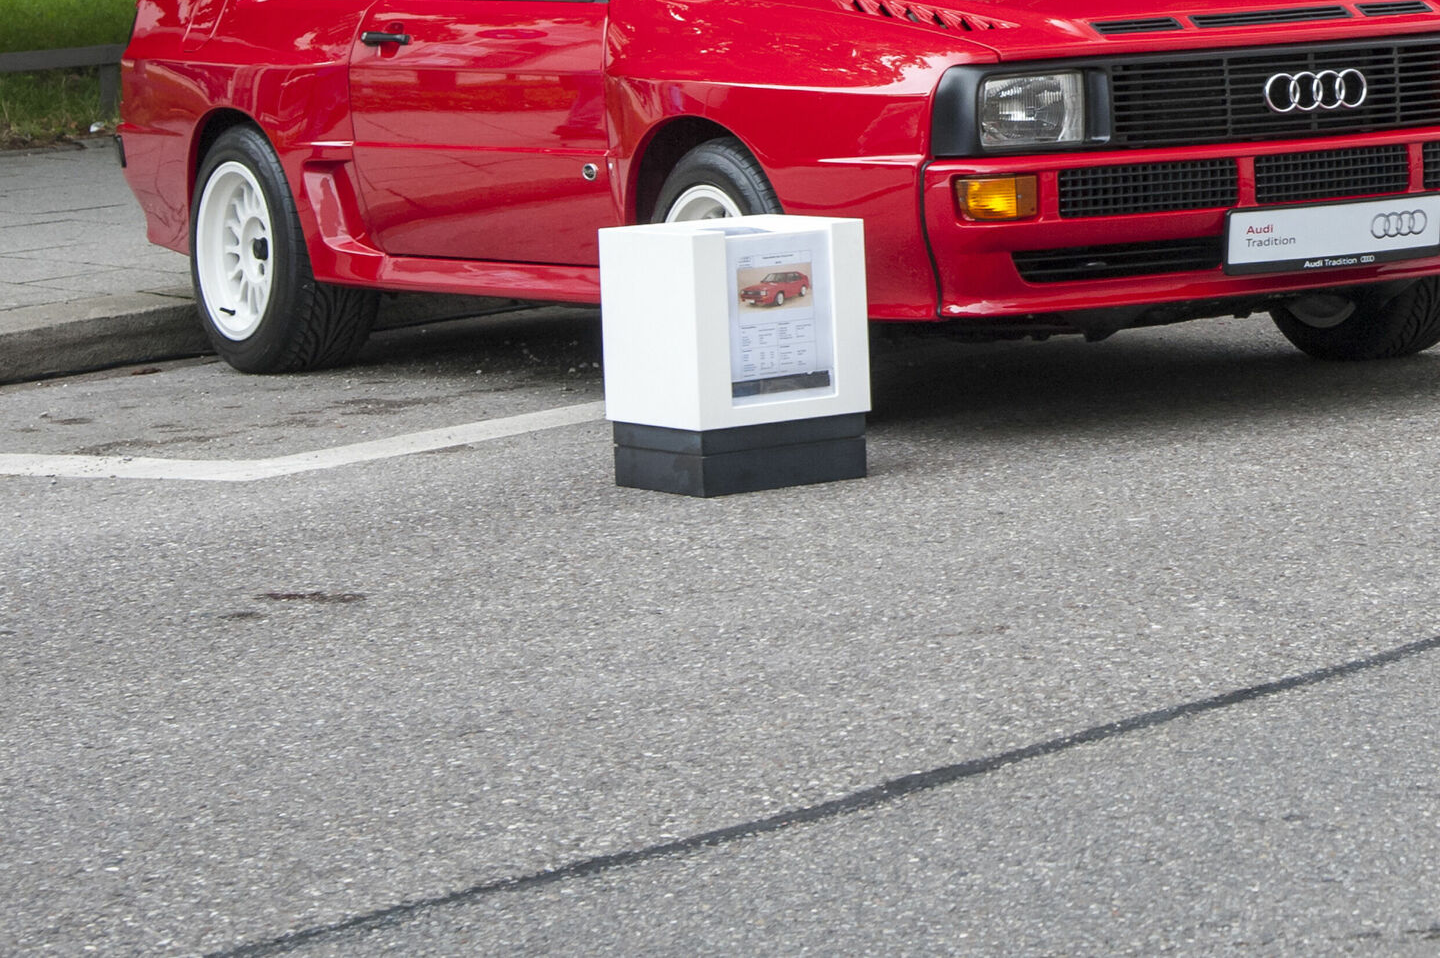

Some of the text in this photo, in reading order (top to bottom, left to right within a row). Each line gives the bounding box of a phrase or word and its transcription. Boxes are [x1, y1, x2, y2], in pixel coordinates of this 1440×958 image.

[1246, 224, 1273, 235] Audi
[1246, 235, 1296, 248] Tradition
[1303, 256, 1358, 268] Audi Tradition
